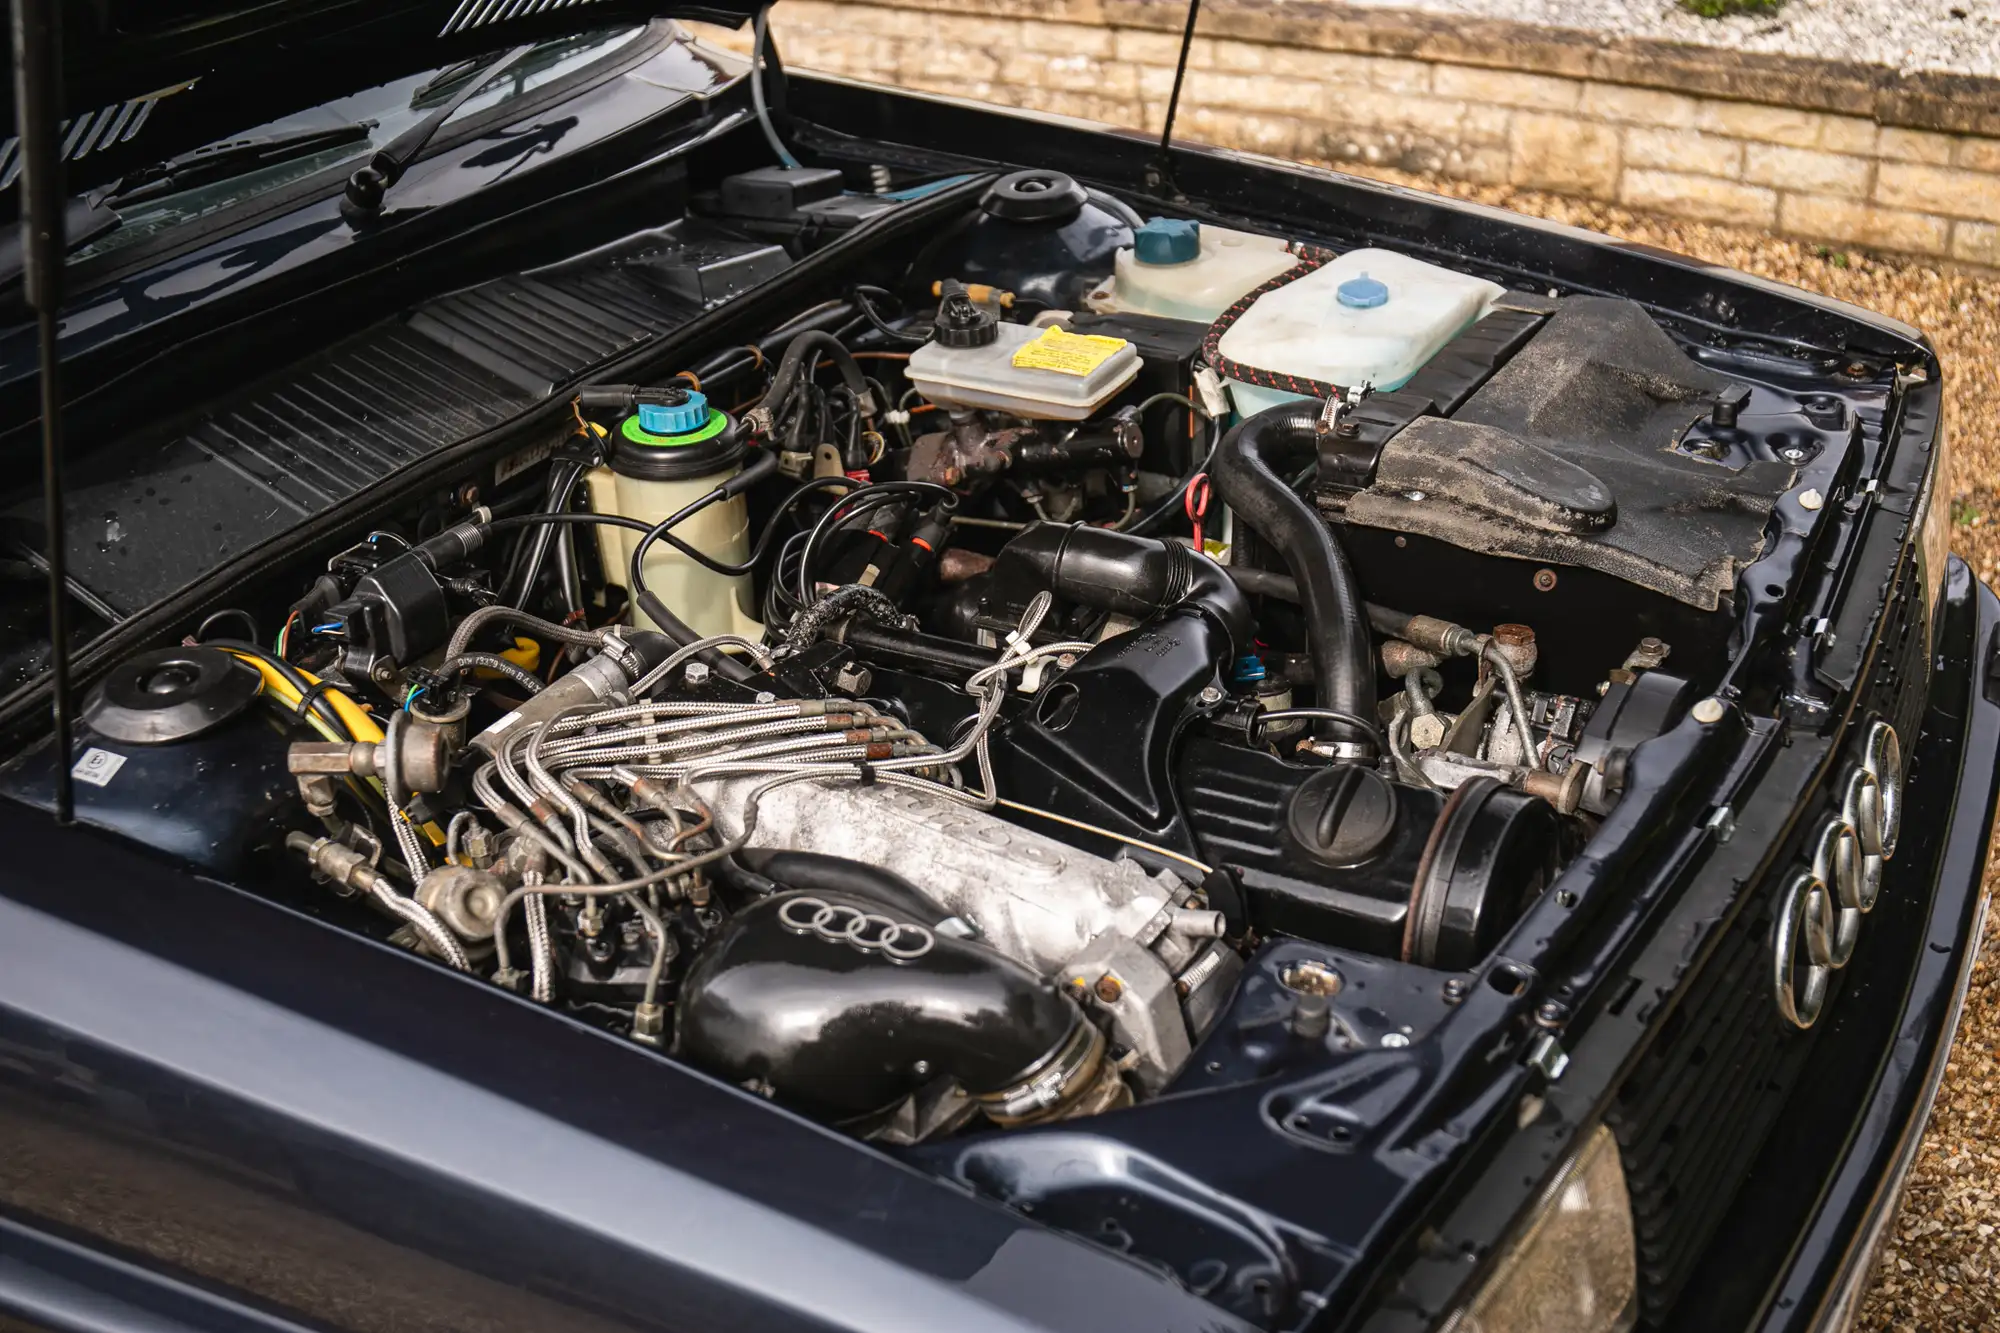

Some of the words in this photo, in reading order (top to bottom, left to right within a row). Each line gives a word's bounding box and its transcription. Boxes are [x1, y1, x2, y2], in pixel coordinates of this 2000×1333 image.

[457, 657, 473, 667] DIN
[475, 656, 499, 668] 73379
[515, 671, 524, 680] B
